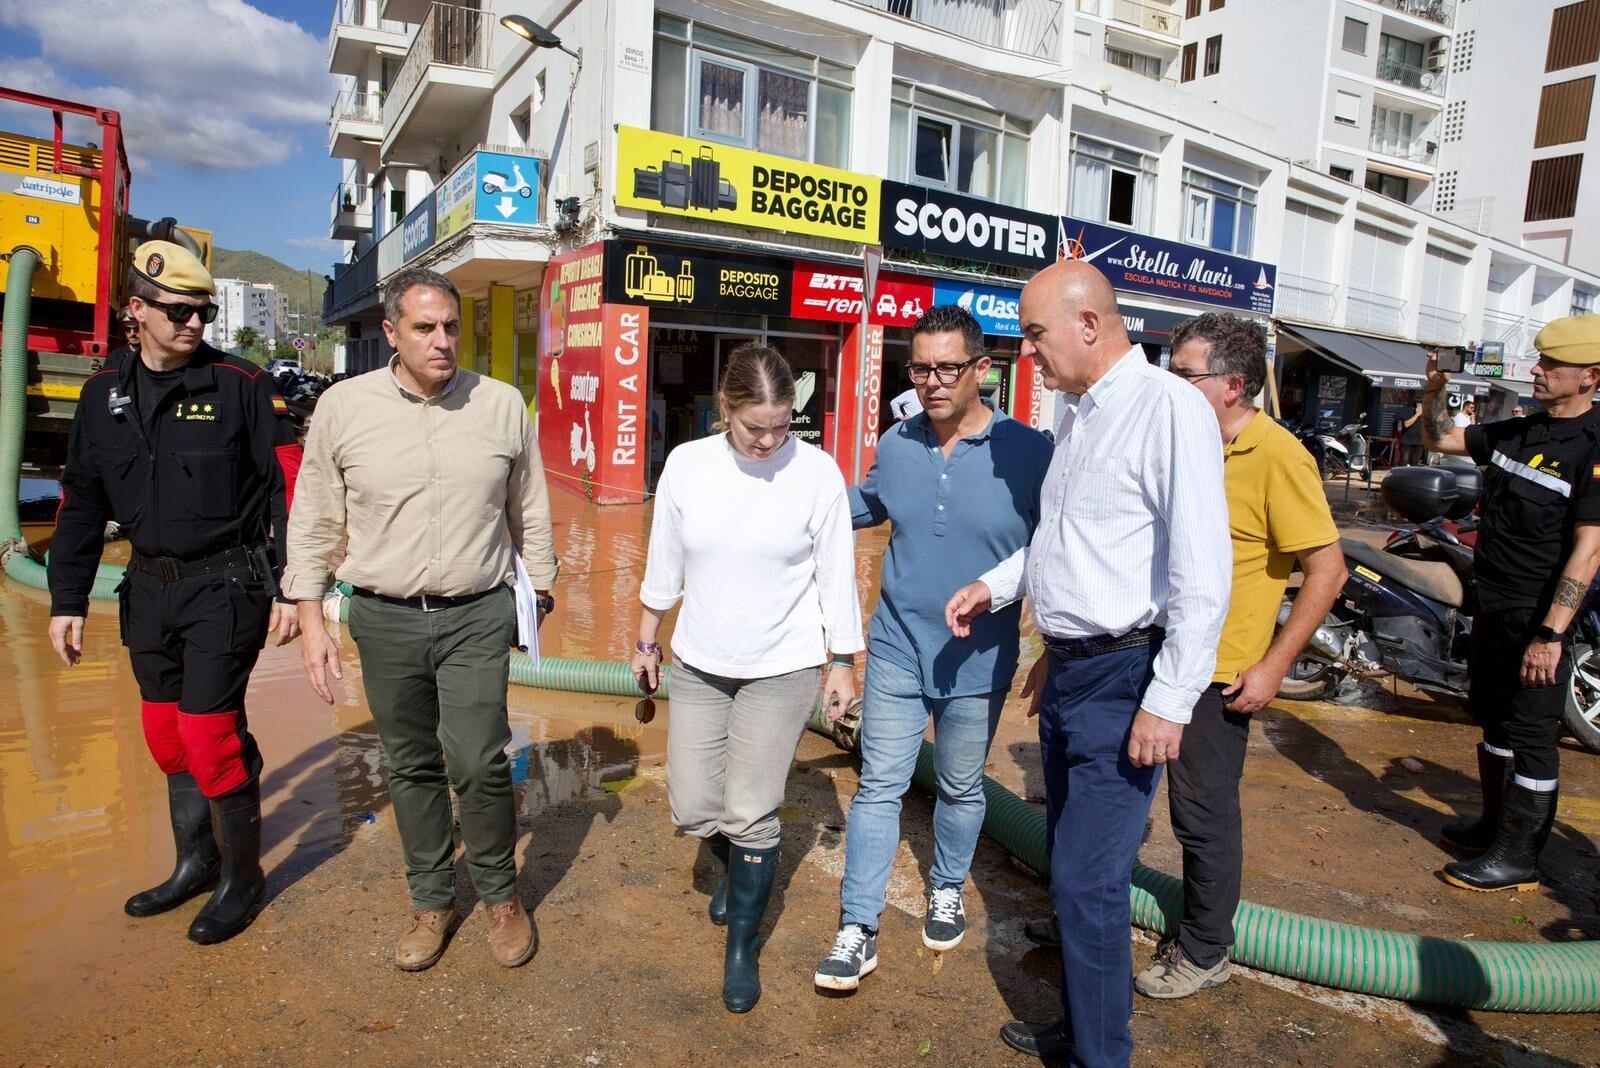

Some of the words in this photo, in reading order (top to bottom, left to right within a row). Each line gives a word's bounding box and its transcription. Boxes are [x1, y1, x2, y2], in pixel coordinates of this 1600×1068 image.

[22, 181, 74, 197] uatripole
[752, 166, 868, 207] DEPOSITO
[28, 216, 38, 224] IN
[751, 191, 867, 230] BAGGAGE
[404, 210, 429, 254] SCOOTER
[894, 198, 1047, 259] SCOOTER
[719, 284, 779, 300] BAGGAGE
[720, 269, 779, 287] DEPOSITO
[808, 272, 864, 292] EXTR
[1124, 272, 1155, 286] ESCUELA
[1155, 278, 1182, 289] NAUTICA
[1182, 283, 1188, 291] Y
[1188, 285, 1198, 293] DE
[1198, 286, 1233, 299] NAVEGACIÓN
[570, 282, 602, 313] LUGGAGE
[826, 297, 864, 314] ren
[567, 321, 603, 348] CONSIGNA
[614, 312, 640, 367] CAR
[570, 370, 600, 403] scooter
[618, 374, 639, 393] A
[864, 329, 883, 448] SCOOTER
[1030, 364, 1044, 429] ONSIG
[612, 399, 636, 466] RENT
[790, 415, 811, 424] Left
